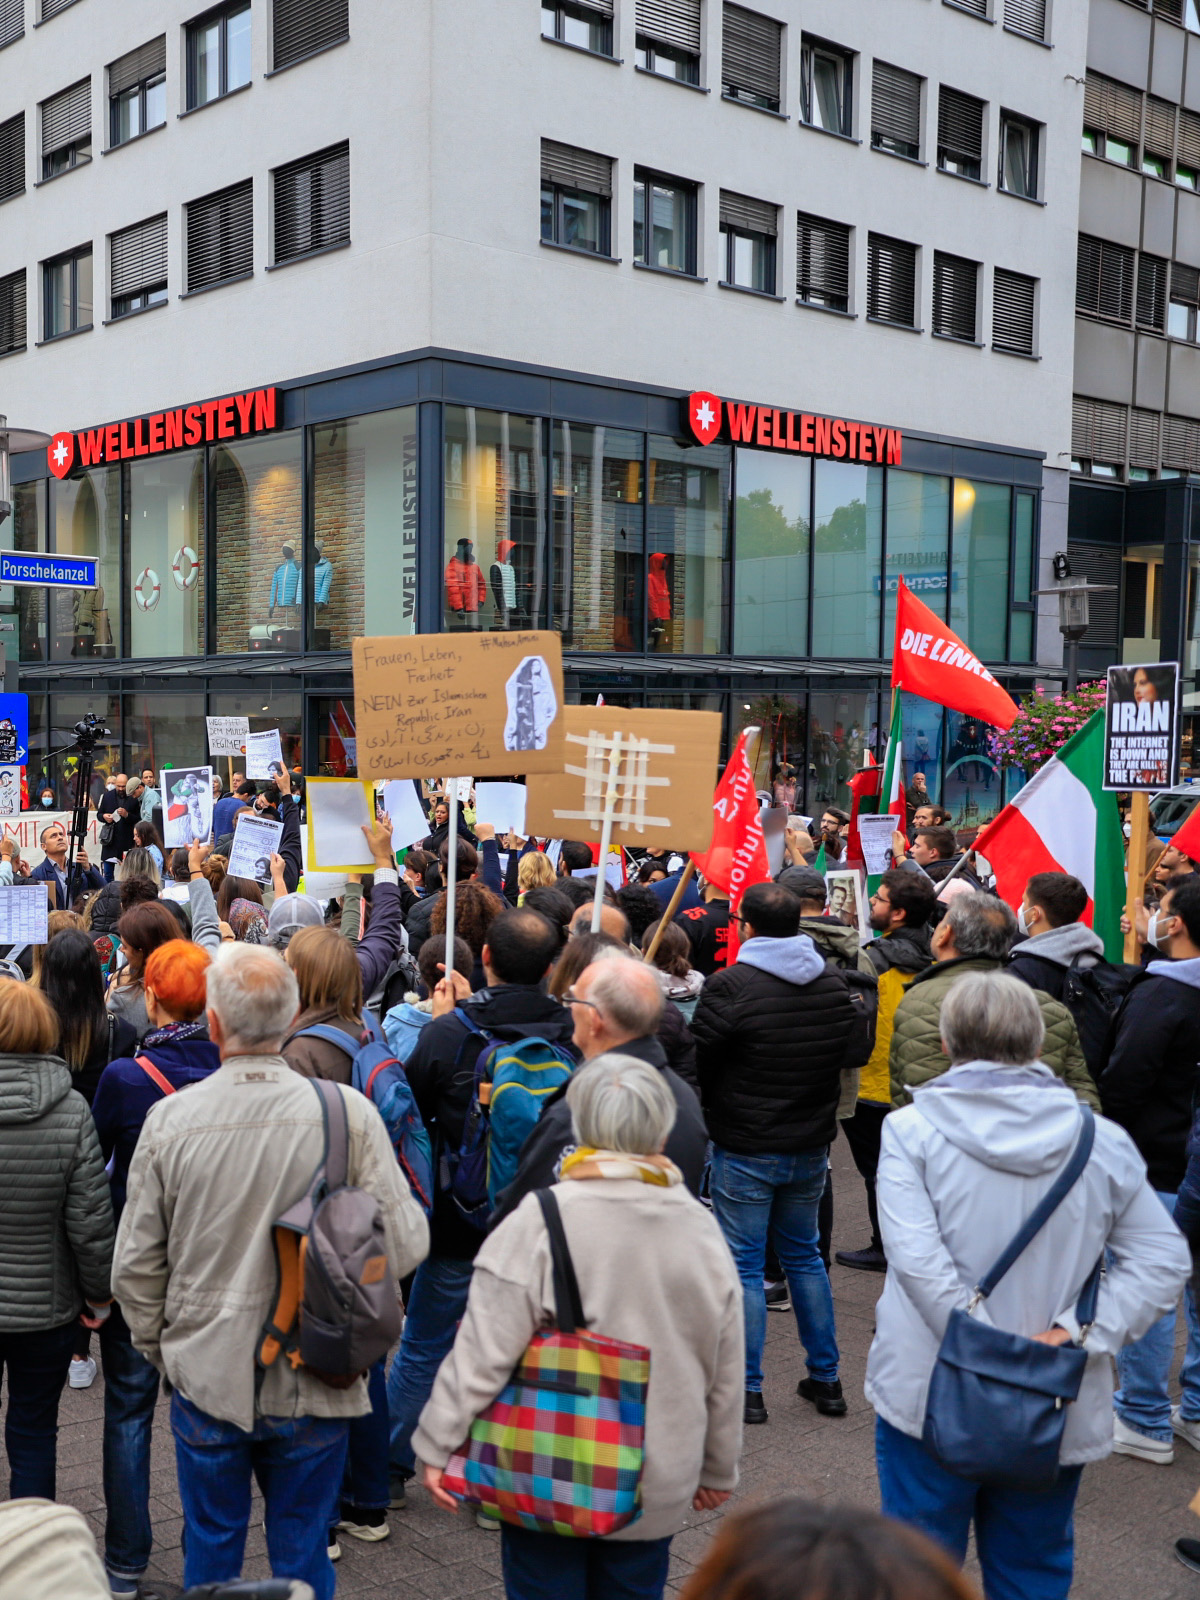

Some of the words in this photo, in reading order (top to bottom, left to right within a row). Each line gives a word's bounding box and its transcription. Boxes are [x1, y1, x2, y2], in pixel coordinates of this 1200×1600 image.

[78, 388, 276, 466] WELLENSTEYN
[726, 401, 902, 465] WELLENSTEYN
[2, 560, 89, 581] Porschekanzel
[900, 627, 934, 658] DIE
[363, 647, 418, 671] Frauen,
[421, 645, 462, 664] Leben,
[406, 667, 456, 684] Freiheit
[362, 693, 402, 713] NEIN
[396, 713, 440, 733] Republic
[444, 705, 472, 721] Iran
[1111, 700, 1170, 733] IRAN
[1109, 749, 1120, 760] IS
[1120, 748, 1147, 760] DOWN
[1148, 748, 1168, 760] AND
[1110, 737, 1127, 749] THE
[1128, 736, 1169, 749] INTERNET
[1109, 760, 1126, 769] THEY
[1126, 760, 1140, 769] ARE
[1109, 769, 1128, 783] THE
[4, 820, 41, 849] MIT
